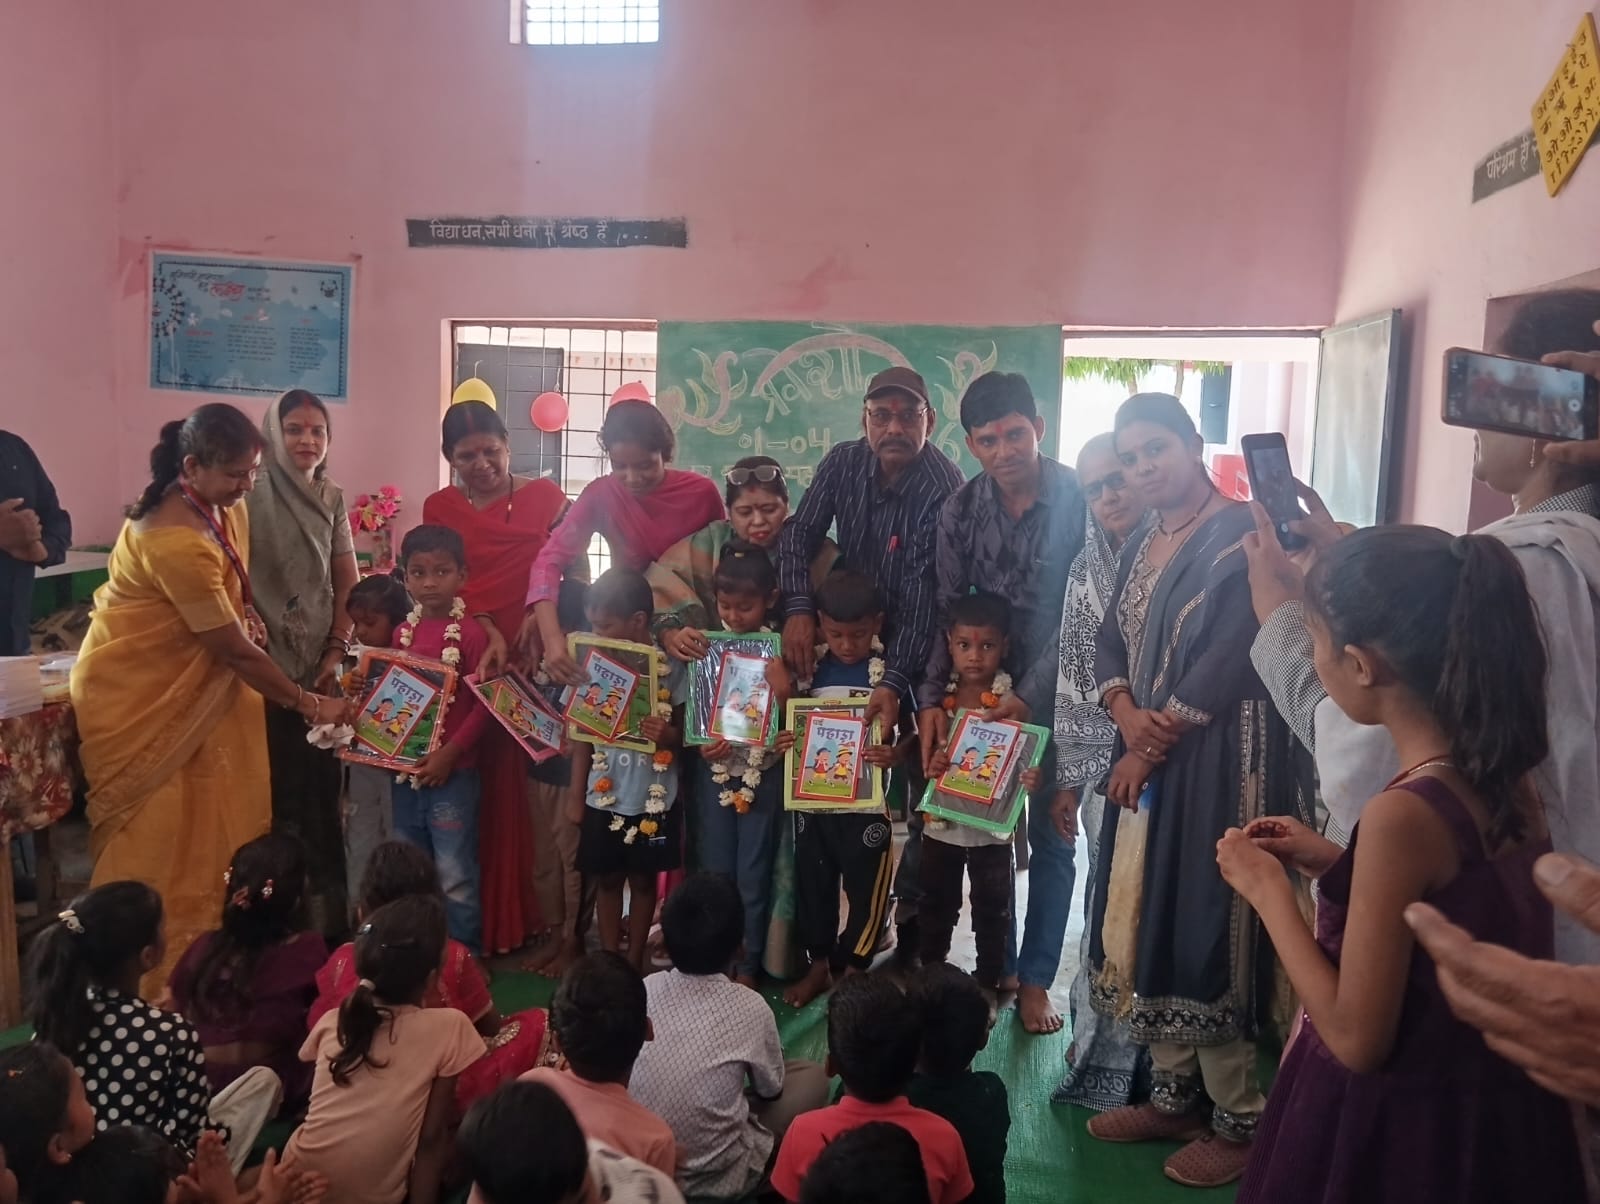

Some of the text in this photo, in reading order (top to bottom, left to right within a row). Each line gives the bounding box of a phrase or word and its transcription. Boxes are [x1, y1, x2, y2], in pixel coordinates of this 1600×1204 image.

[1487, 151, 1517, 180] परिश्रम
[429, 220, 460, 239] विद्या
[484, 220, 511, 239] सभी
[596, 219, 608, 244] है
[594, 663, 627, 687] पहाड़ा
[391, 677, 424, 703] पहाड़ा
[817, 726, 855, 743] पहाड़ा
[971, 726, 1008, 745] पहाड़ा
